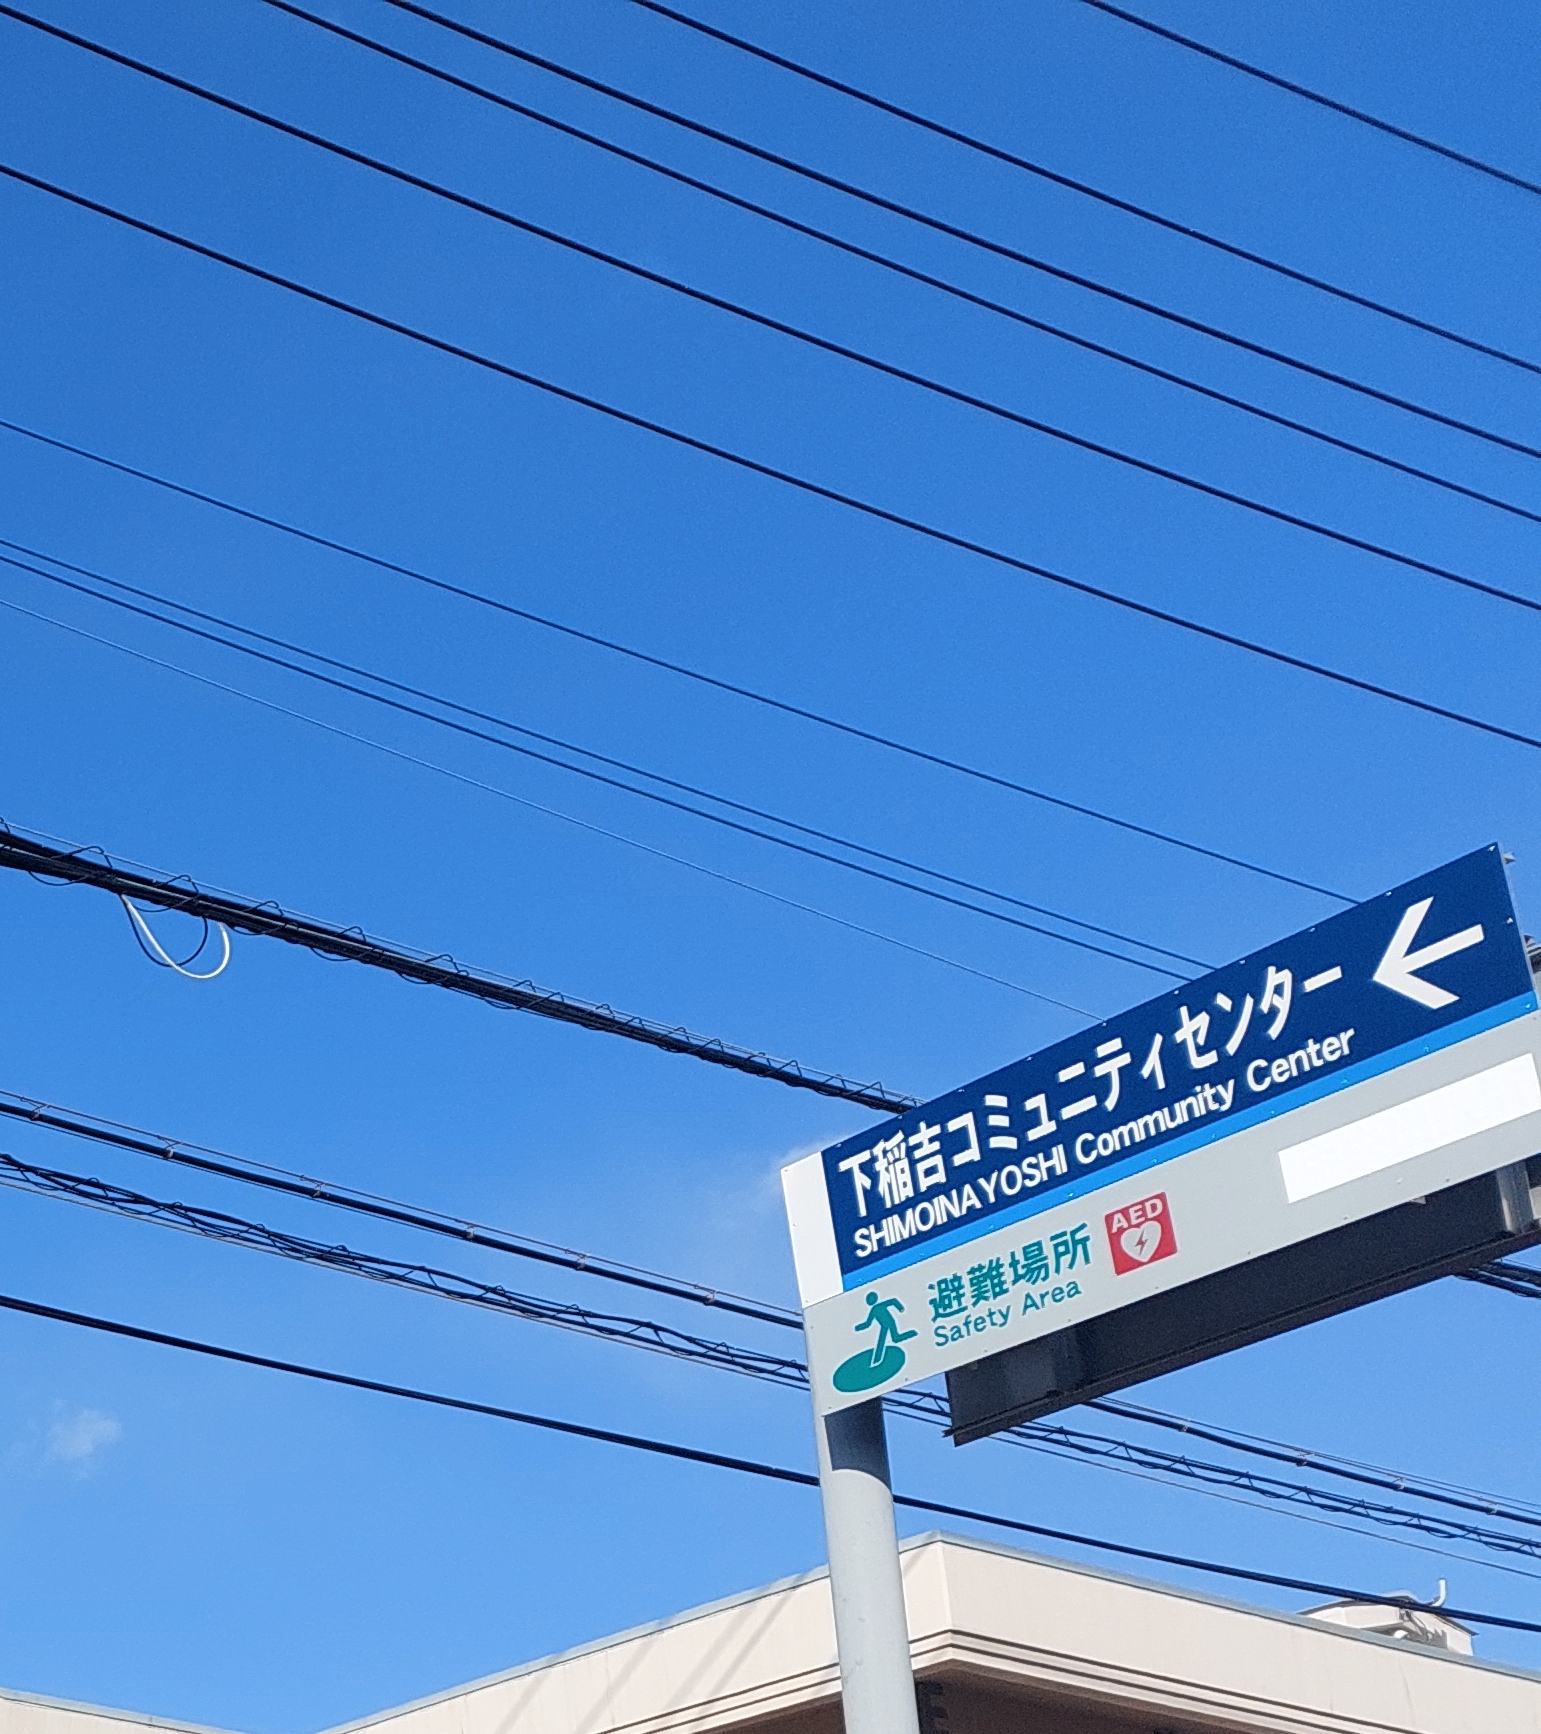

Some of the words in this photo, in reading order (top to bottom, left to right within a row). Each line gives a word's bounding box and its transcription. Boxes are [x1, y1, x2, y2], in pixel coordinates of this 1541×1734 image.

[837, 965, 1343, 1219] 下稲吉コミュニティセンター
[854, 1144, 1068, 1258] SHIMOINAYOSHI
[1074, 1079, 1234, 1162] Community
[1247, 1028, 1355, 1093] Center
[1111, 1198, 1165, 1233] AED
[927, 1222, 1093, 1324] 避難場所
[933, 1305, 1011, 1348] Safety
[1020, 1277, 1082, 1315] Area
